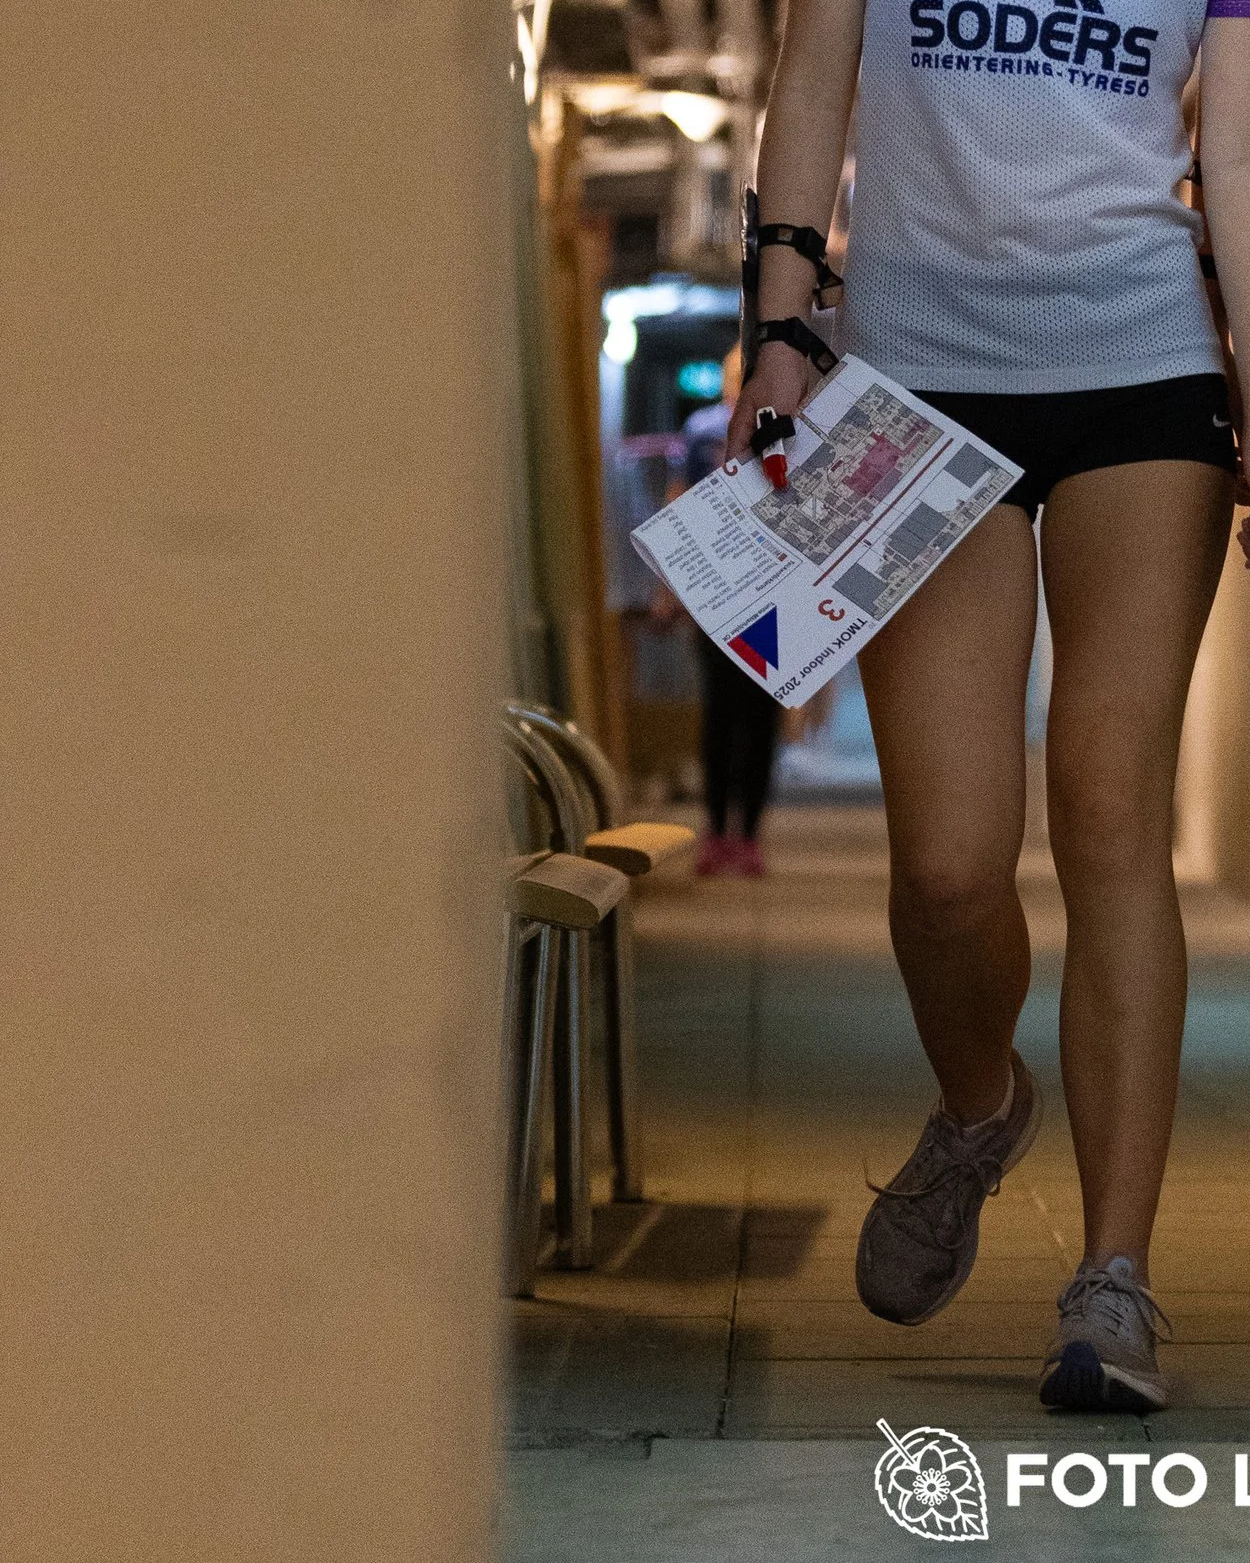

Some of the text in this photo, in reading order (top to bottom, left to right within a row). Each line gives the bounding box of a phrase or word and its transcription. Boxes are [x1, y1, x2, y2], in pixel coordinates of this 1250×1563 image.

[817, 598, 845, 623] 3
[772, 617, 867, 701] TMOK Indoor 2025
